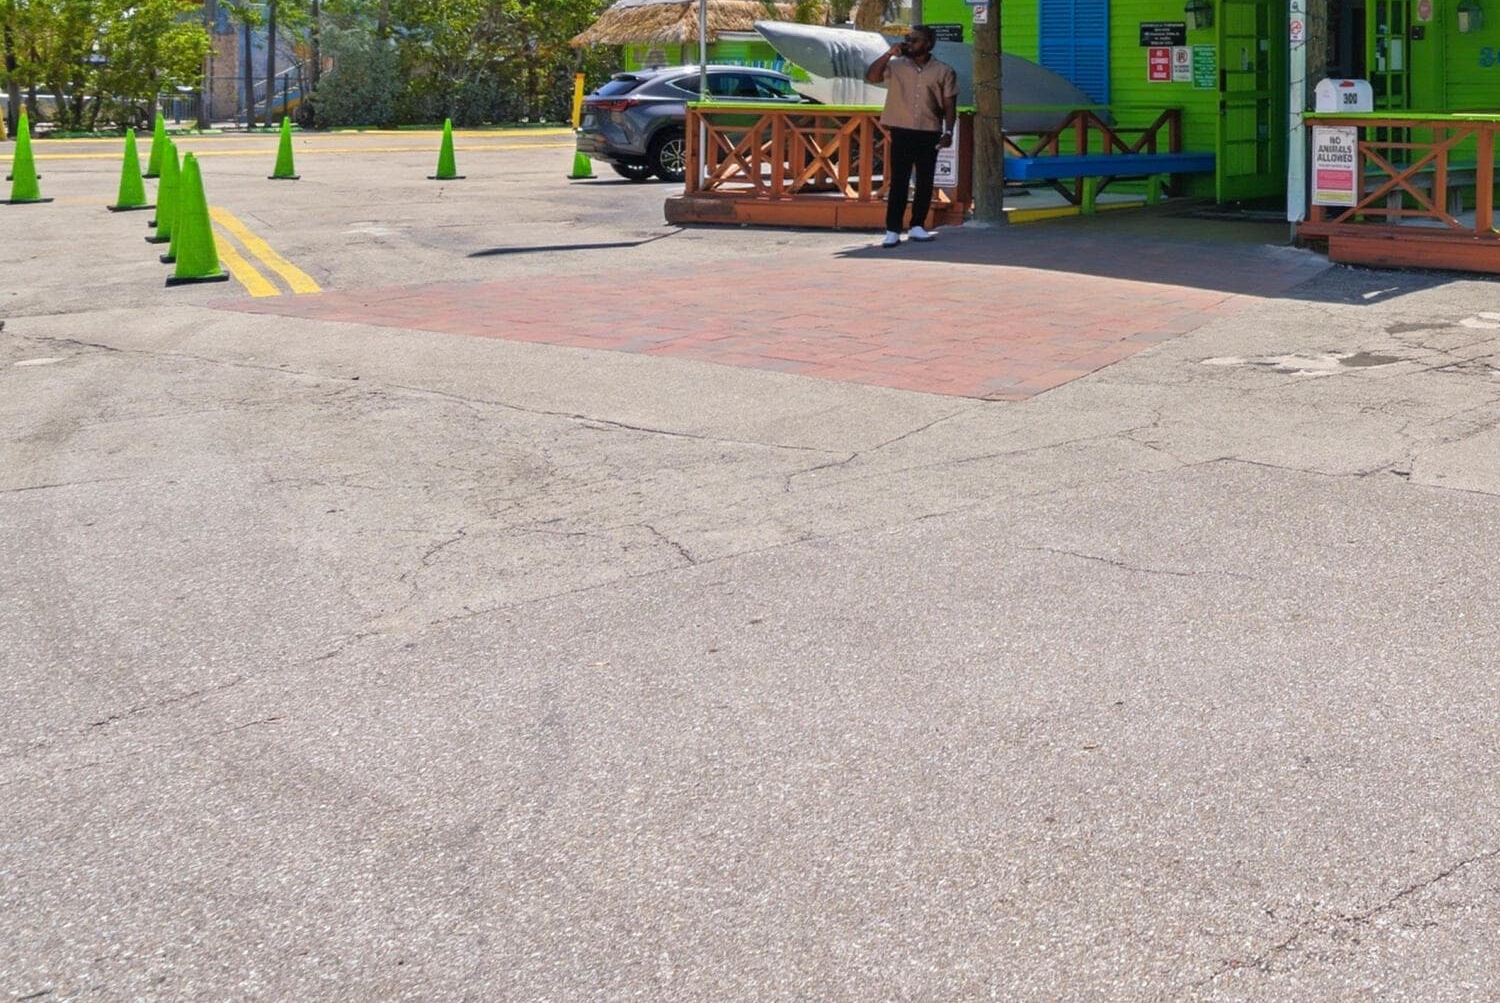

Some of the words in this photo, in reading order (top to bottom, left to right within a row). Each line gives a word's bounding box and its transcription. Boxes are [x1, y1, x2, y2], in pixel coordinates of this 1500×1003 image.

[1343, 93, 1358, 105] 300
[1329, 136, 1342, 145] NO
[1317, 145, 1353, 154] ANIMALS
[1316, 154, 1353, 163] ALLOWED
